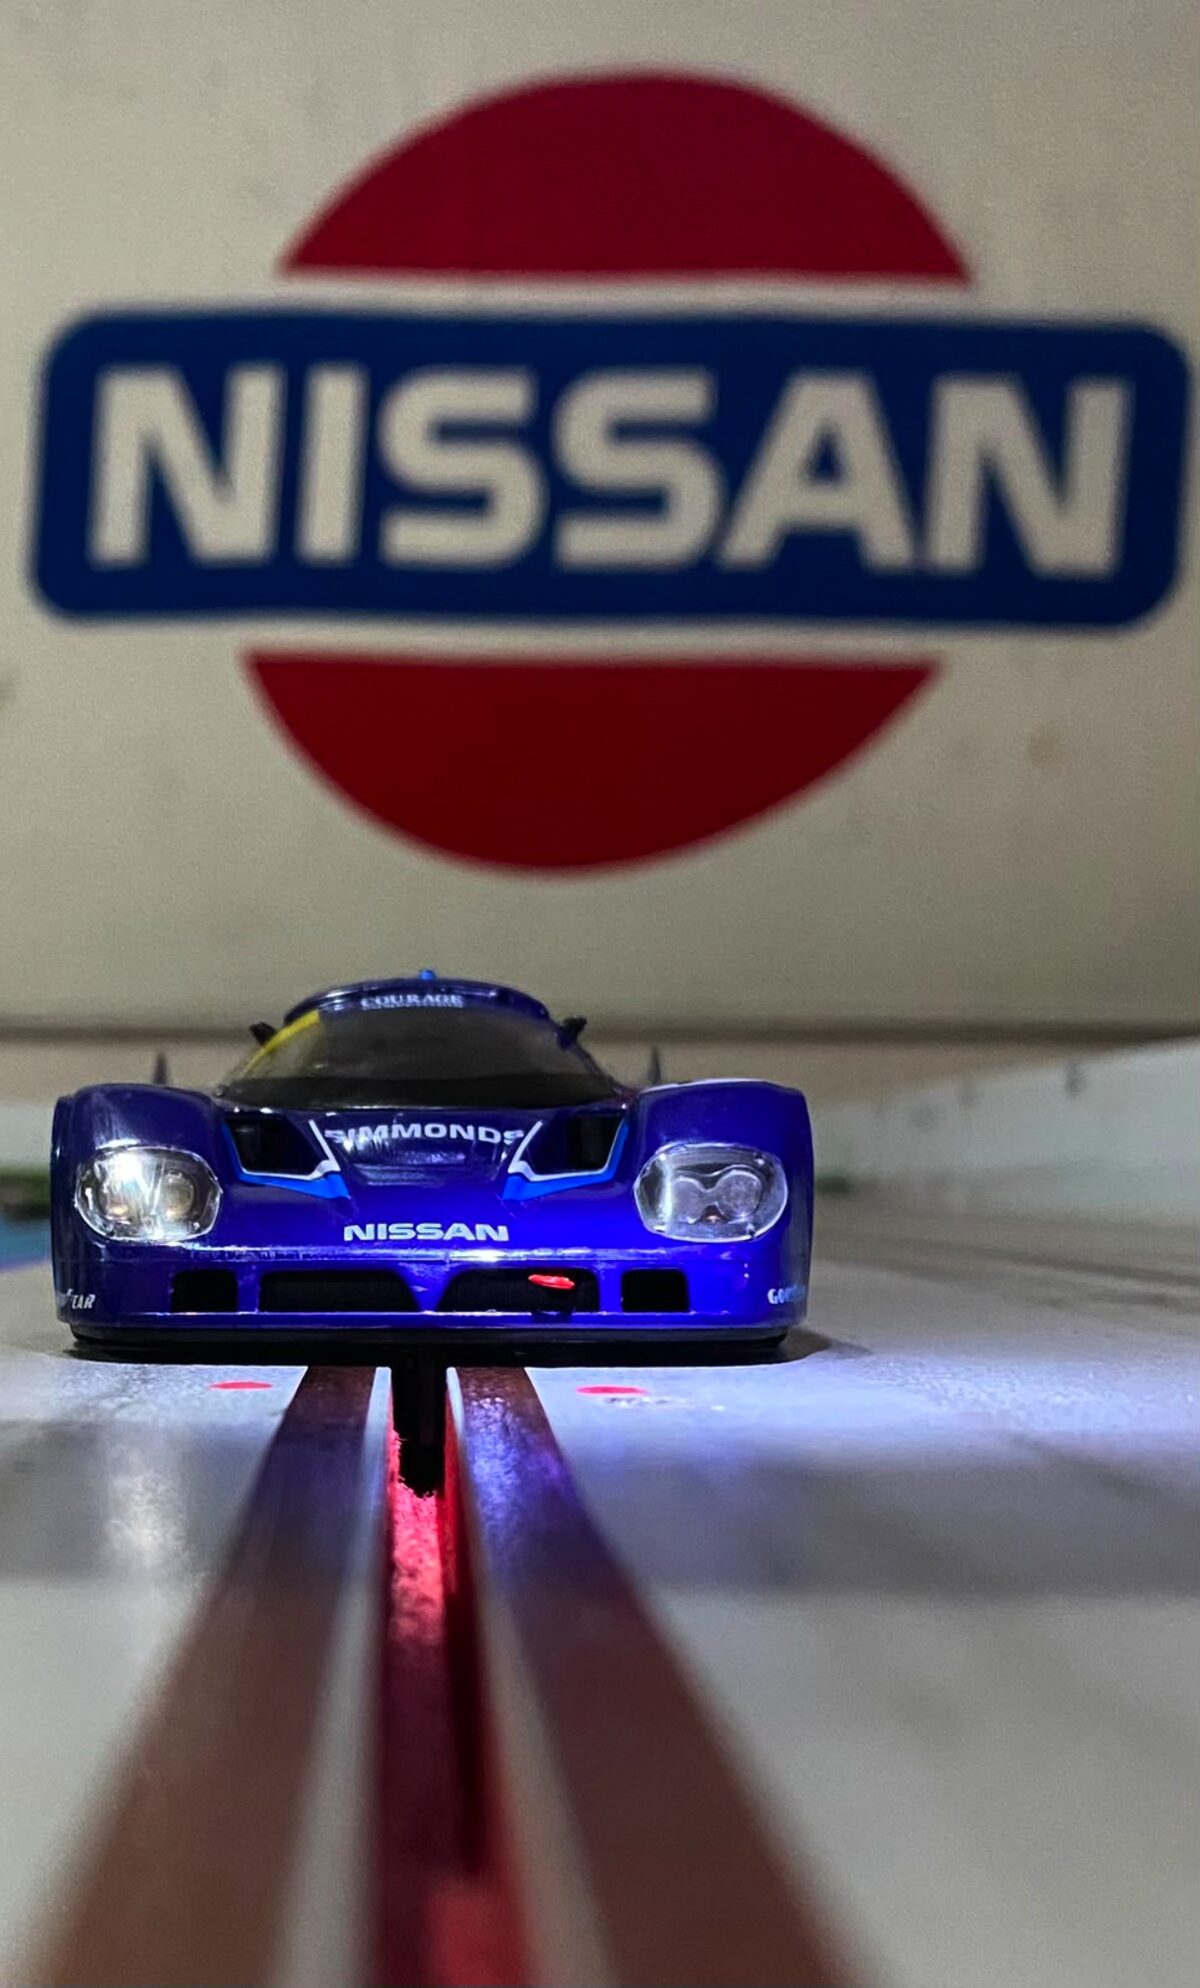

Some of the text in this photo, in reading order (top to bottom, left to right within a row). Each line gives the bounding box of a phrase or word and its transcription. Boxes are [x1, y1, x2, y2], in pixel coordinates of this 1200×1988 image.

[89, 364, 1130, 579] NISSAN
[361, 994, 464, 1006] COURAGE
[325, 1123, 524, 1146] SIMMONDS
[343, 1223, 509, 1242] NISSAN
